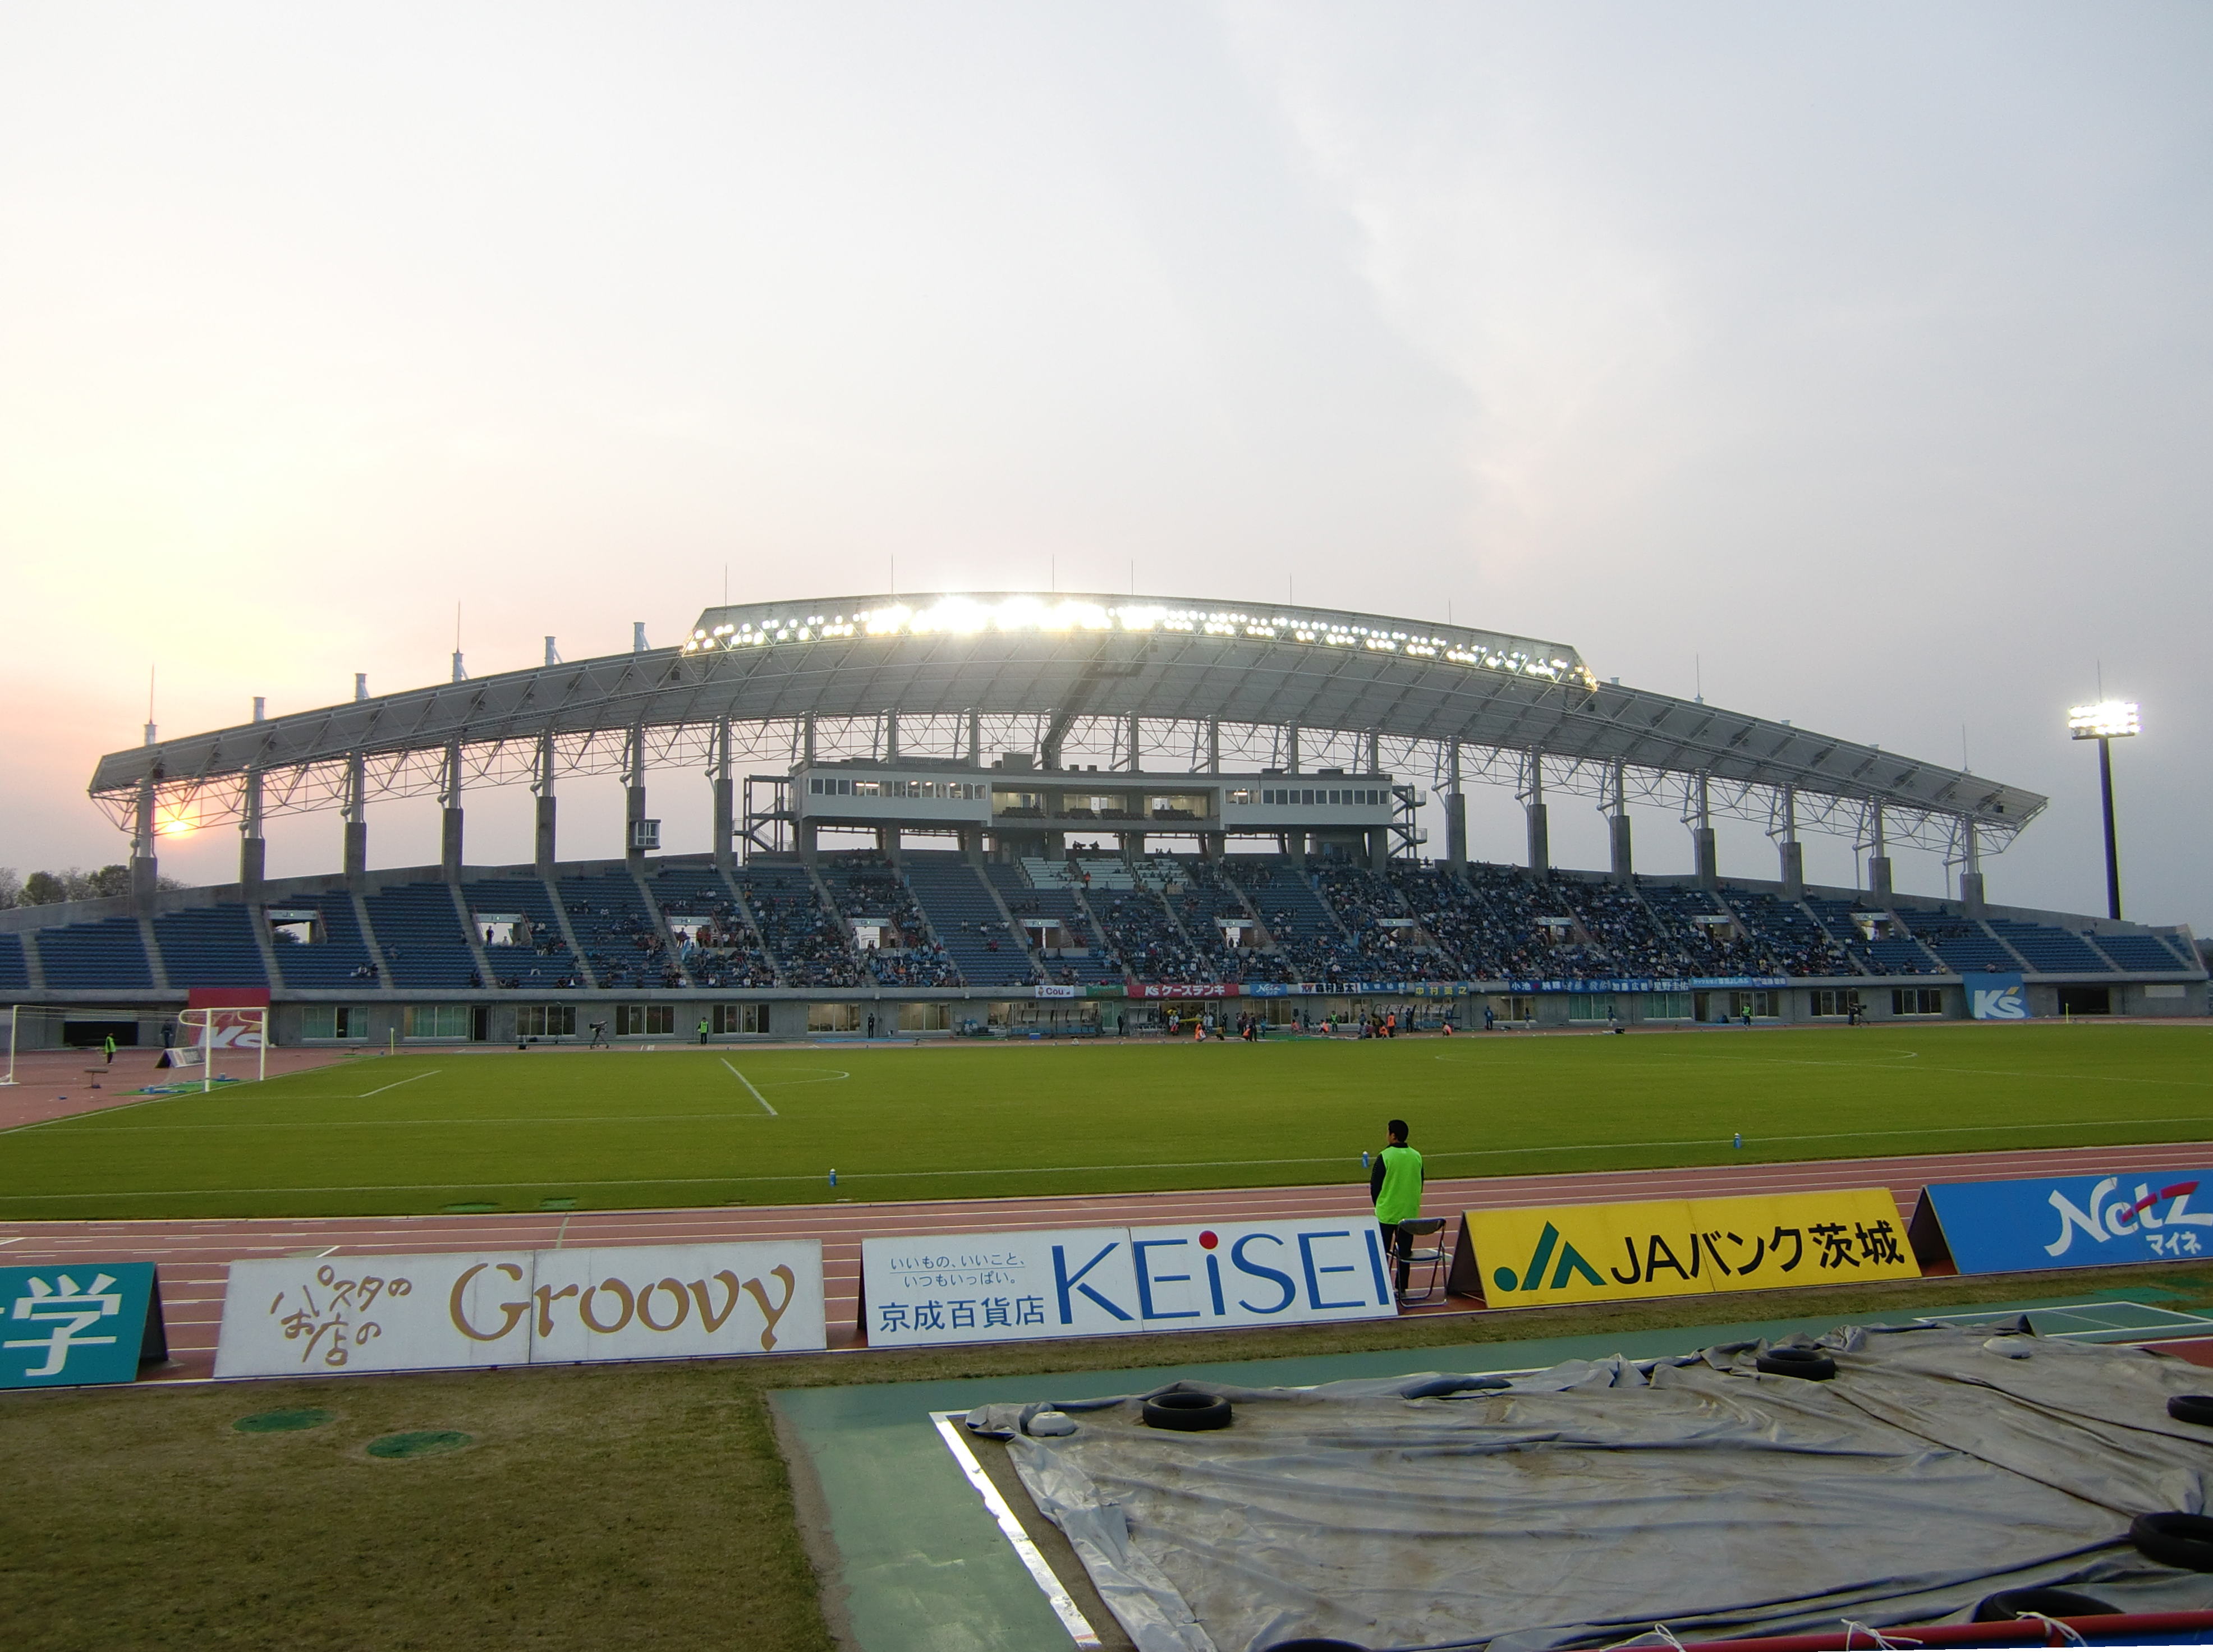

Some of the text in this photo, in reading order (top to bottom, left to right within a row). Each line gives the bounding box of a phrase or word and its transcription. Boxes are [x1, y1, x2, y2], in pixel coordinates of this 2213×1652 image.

[1162, 984, 1225, 996] ケーズデンキ
[890, 1252, 1025, 1270] いいもの、いいこと、
[1611, 1220, 1906, 1285] JAバンク茨城
[2146, 1230, 2202, 1256] マイネ
[270, 1264, 412, 1317] パスタの
[904, 1270, 1016, 1288] いつもいっぱい。
[0, 1273, 122, 1377] 学
[449, 1262, 796, 1351] Groovy
[878, 1295, 1045, 1332] 京成百貨店
[281, 1312, 382, 1366] お店の
